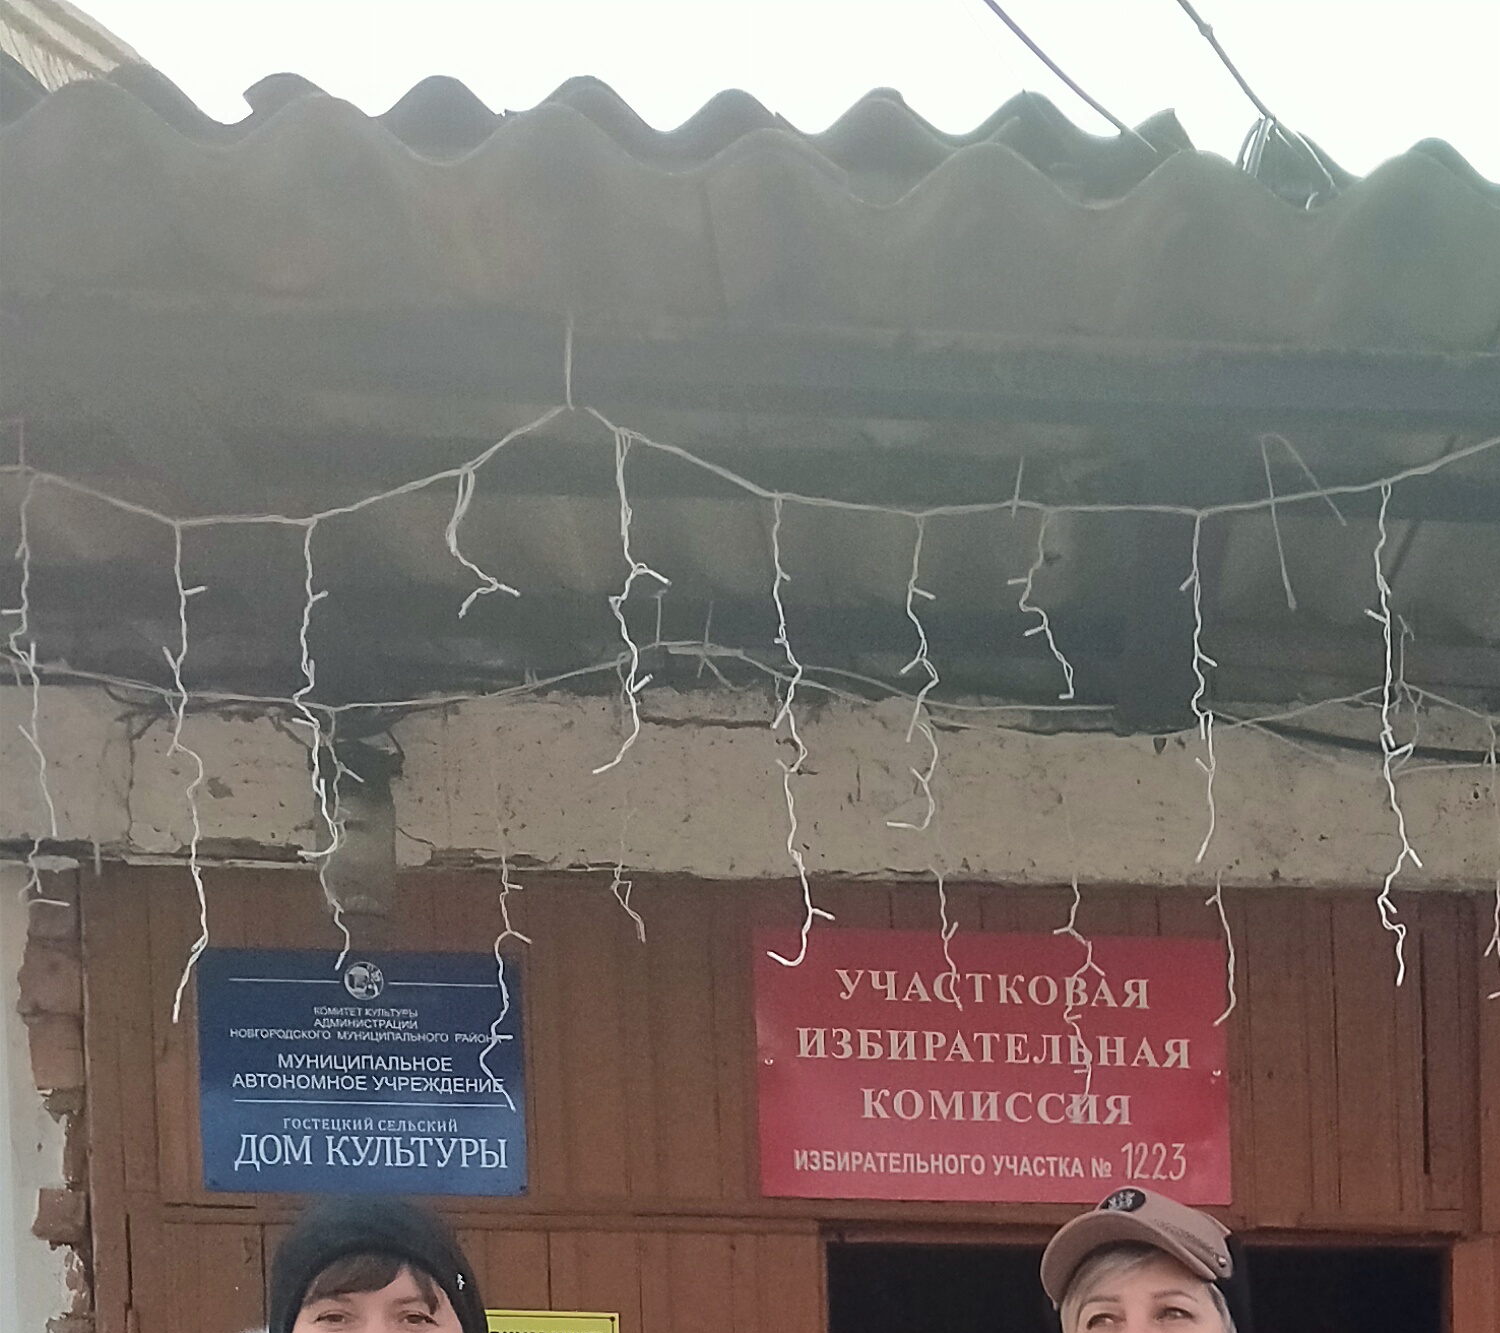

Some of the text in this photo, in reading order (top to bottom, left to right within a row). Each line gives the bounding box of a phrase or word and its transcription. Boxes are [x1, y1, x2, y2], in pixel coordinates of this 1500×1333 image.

[835, 968, 1150, 1010] УЧАСТКОВАЯ
[313, 1006, 419, 1018] КОМИТЕТ КУЛЬТУРЫ
[229, 1028, 332, 1040] НОВГОРОДСКОГО
[337, 1030, 450, 1043] МУНИЦИПАЛЬНОГО
[313, 1018, 419, 1031] АДМИНИСТРАЦИИ
[796, 1026, 1192, 1070] ИЗБИРАТЕЛЬНАЯ
[277, 1053, 454, 1074] МУНИЦИПАЛЬНОЕ
[232, 1073, 505, 1095] АВТОНОМНОЕ УЧРЕЖДЕНИЕ
[860, 1087, 1132, 1126] КОМИССИЯ
[283, 1117, 458, 1134] ГОСТЕЦКИЙ СЕЛЬСКИЙ
[234, 1133, 509, 1172] ДОМ КУЛЬТУРЫ
[793, 1142, 1188, 1181] ИЗБИРАТЕЛЬНОГО УЧАСТКА № 1223
